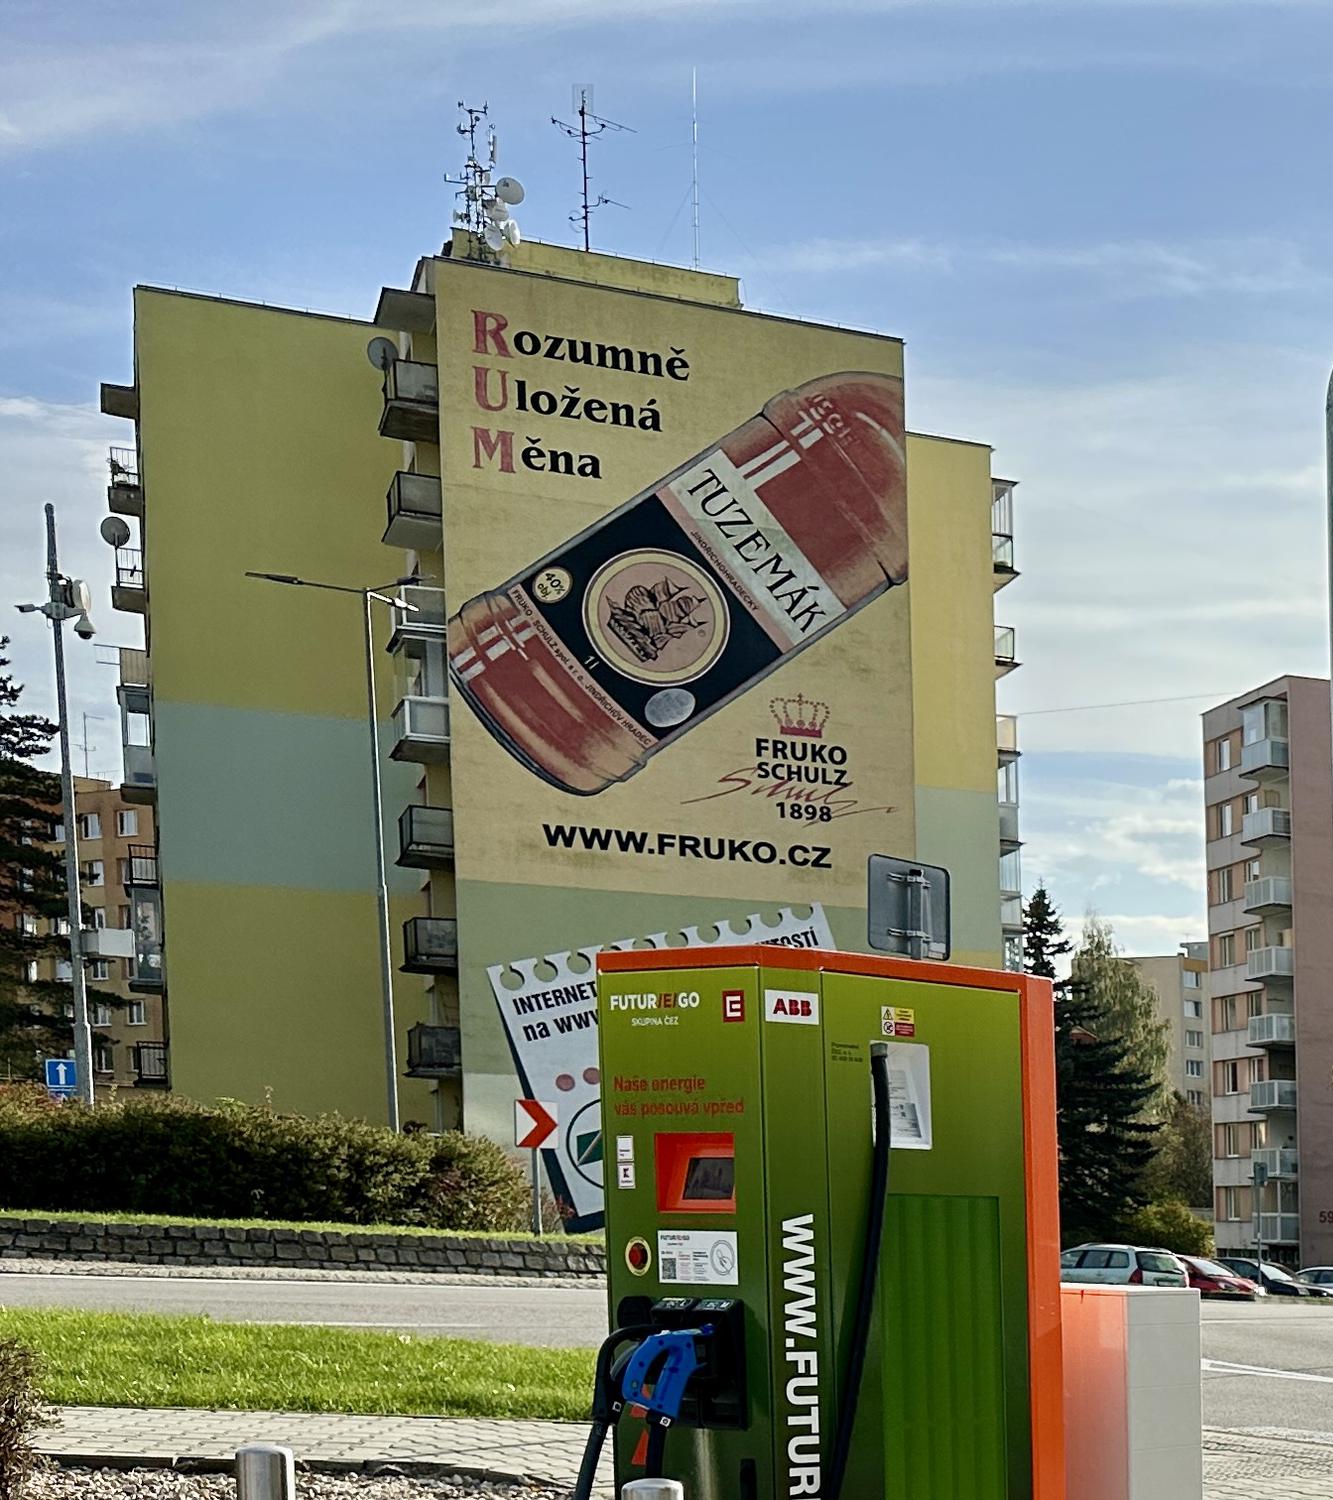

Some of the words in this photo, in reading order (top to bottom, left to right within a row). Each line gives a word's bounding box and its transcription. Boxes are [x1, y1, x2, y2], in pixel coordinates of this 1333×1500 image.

[470, 309, 691, 382] Rozumně
[473, 365, 663, 433] Uložená
[471, 426, 603, 481] Měna
[687, 468, 827, 633] TUZEMÁK
[545, 573, 566, 595] 40%
[511, 589, 533, 617] FRUKO
[533, 620, 558, 650] SCHULZ
[621, 718, 652, 746] HRADEC
[755, 737, 848, 766] FRUKO
[756, 761, 848, 787] SCHULZ
[775, 802, 832, 823] 1898
[541, 822, 833, 869] WWW.FRUKO.CZ
[609, 991, 700, 1011] FUTUR/E/GO
[772, 997, 813, 1017] ABB
[522, 1021, 551, 1042] na
[631, 1017, 663, 1027] SKUPINA
[663, 1015, 679, 1026] ČEZ
[614, 1076, 650, 1092] Naše
[652, 1077, 705, 1094] energie
[614, 1100, 636, 1117] vás
[641, 1098, 699, 1119] posouvá
[703, 1097, 745, 1117] vpřed
